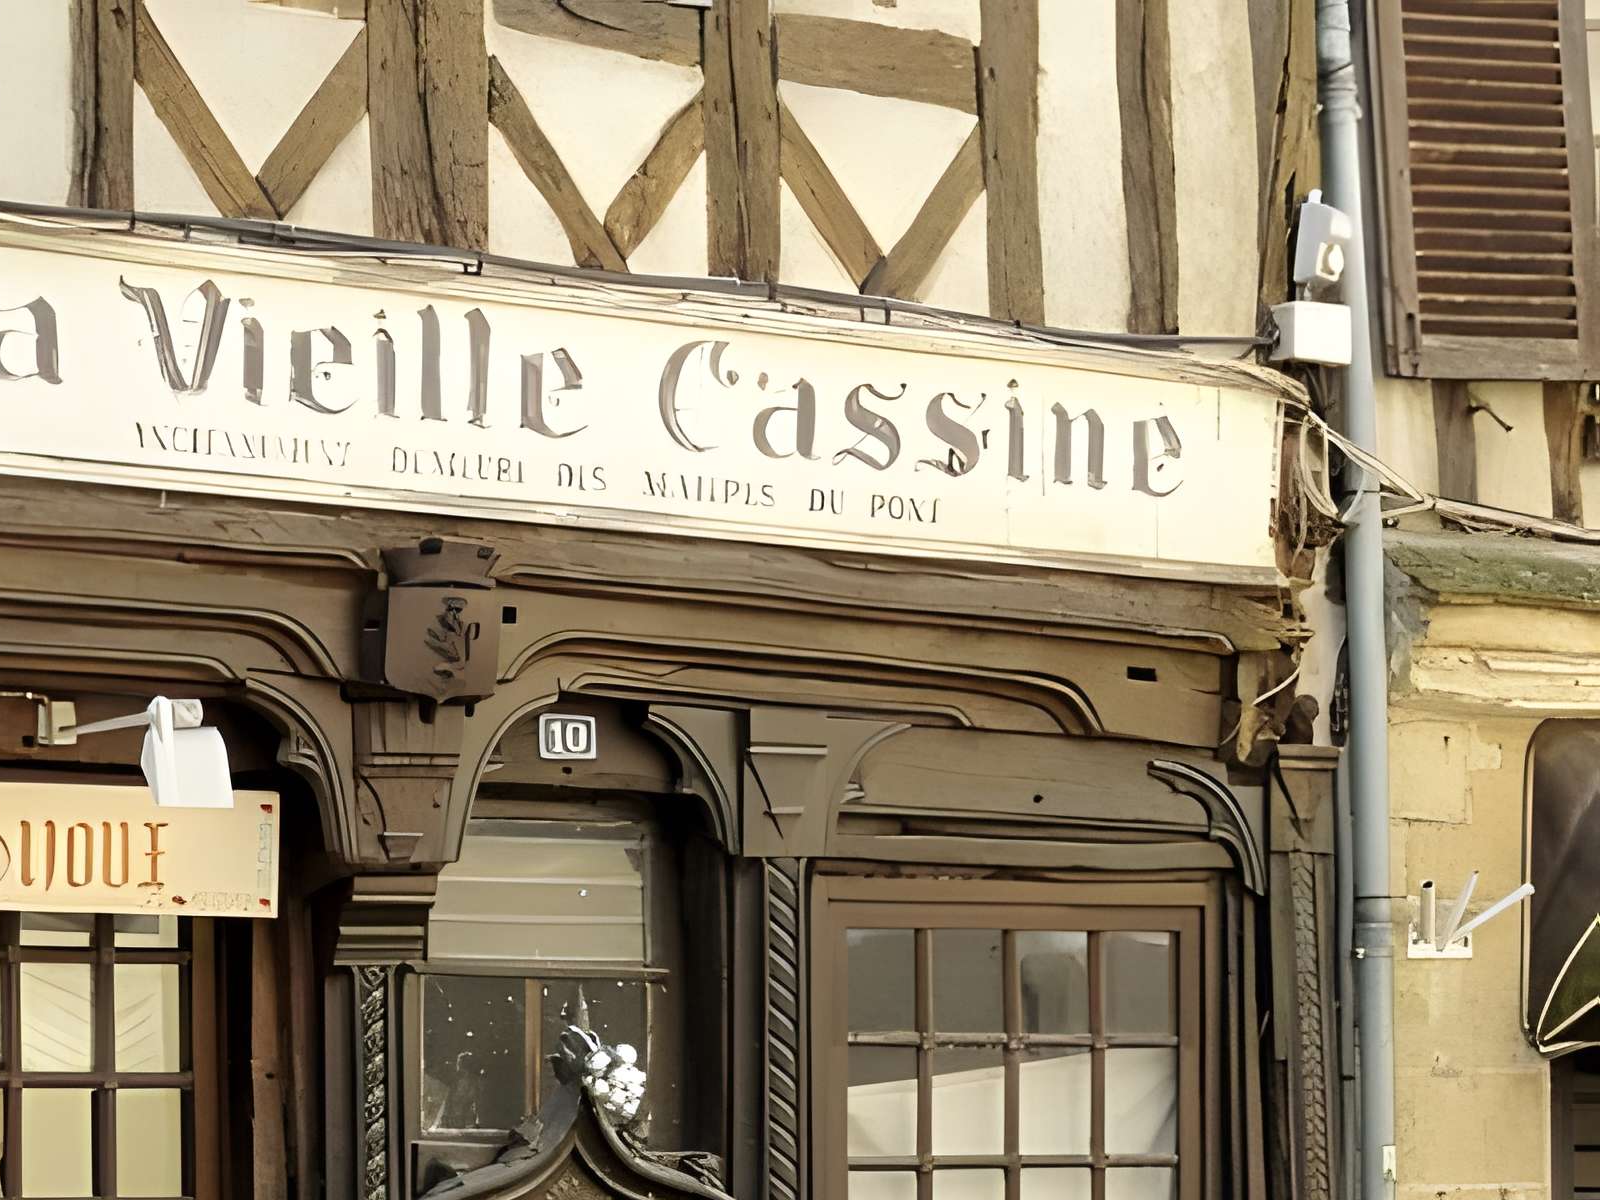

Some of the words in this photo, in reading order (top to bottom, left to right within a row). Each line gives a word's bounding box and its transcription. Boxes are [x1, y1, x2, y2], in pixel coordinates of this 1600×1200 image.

[119, 275, 590, 440] Vieille
[657, 340, 1185, 498] Cassine
[808, 488, 845, 515] DU
[548, 719, 588, 753] 10
